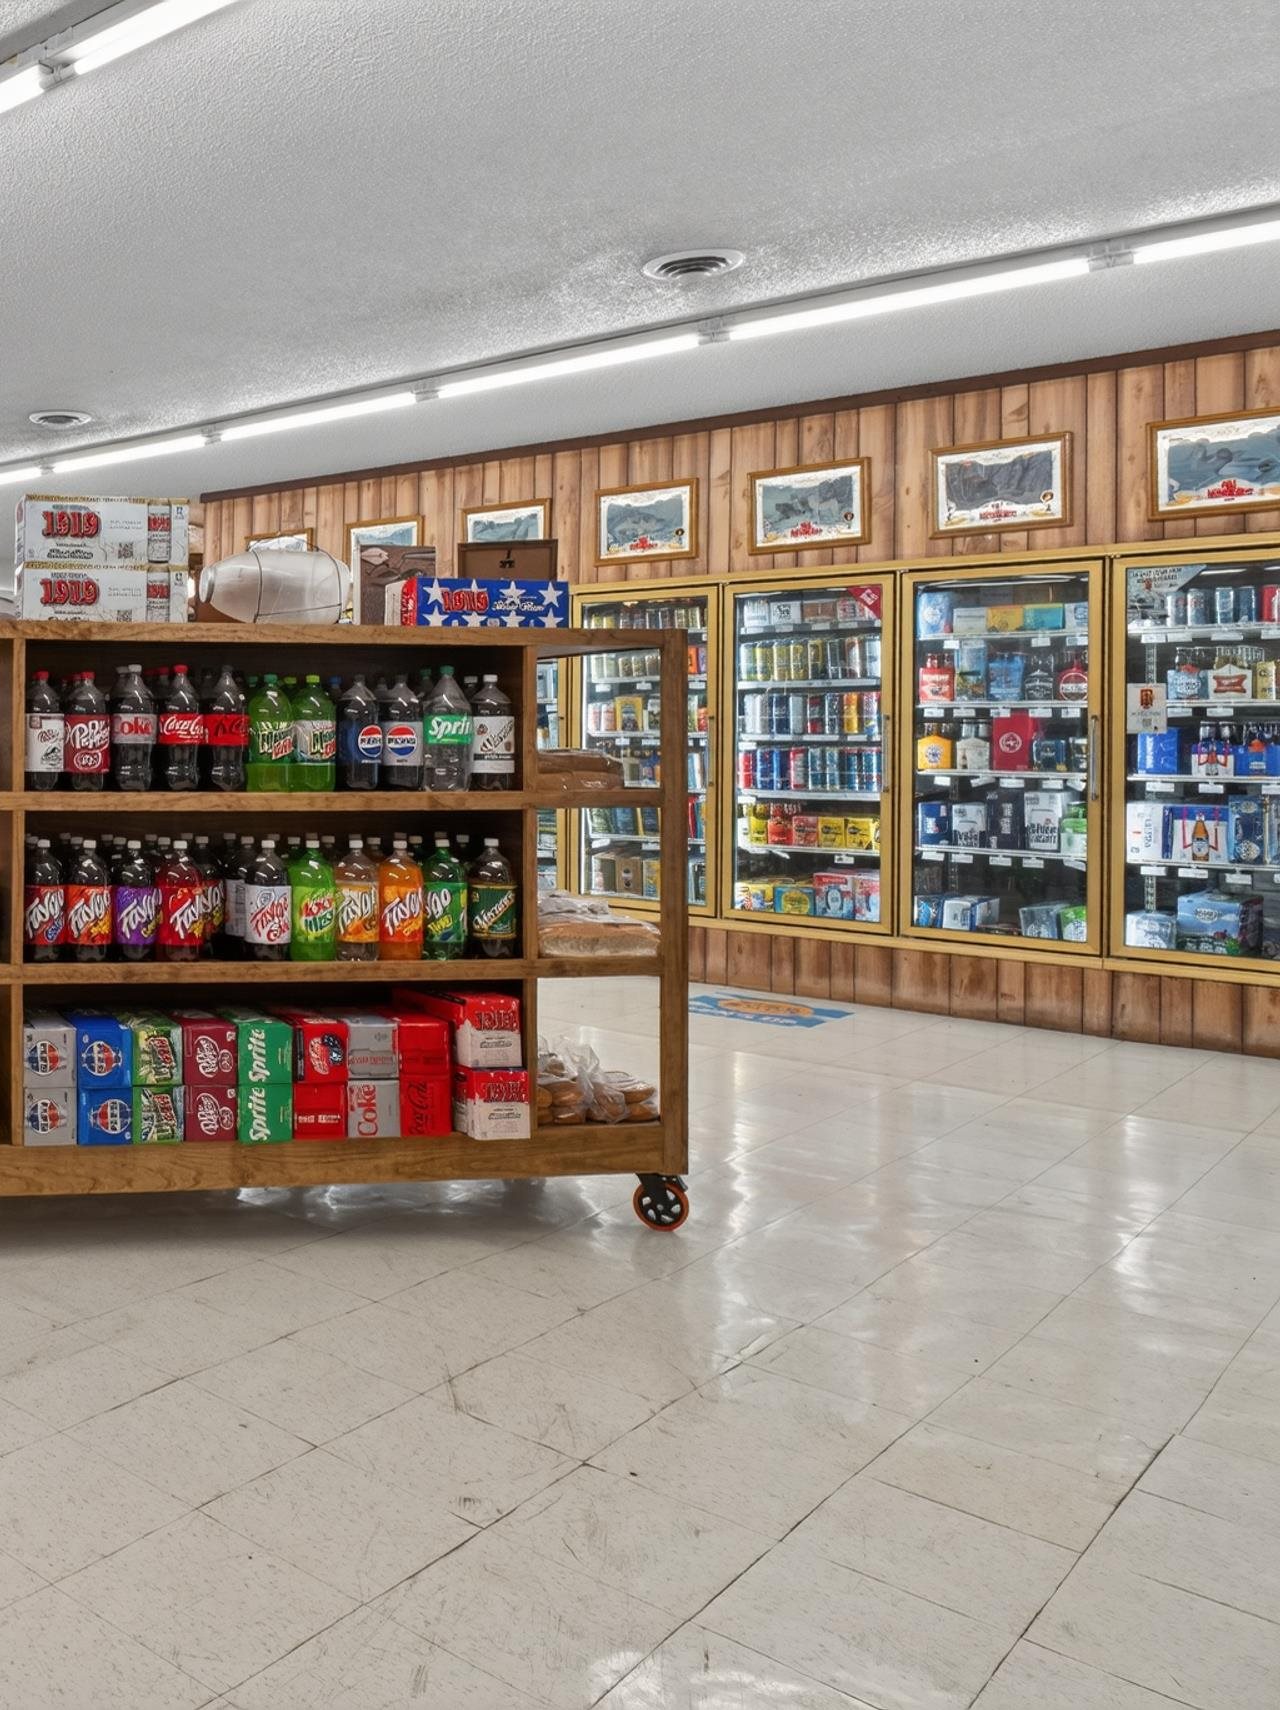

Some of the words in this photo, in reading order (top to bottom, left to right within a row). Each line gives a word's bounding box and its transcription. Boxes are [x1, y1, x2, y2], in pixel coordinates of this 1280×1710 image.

[42, 510, 100, 538] 1919
[40, 578, 99, 605] 1919
[248, 1028, 271, 1082] Sprite
[248, 1087, 271, 1141] Sprite
[357, 1084, 379, 1137] Coke
